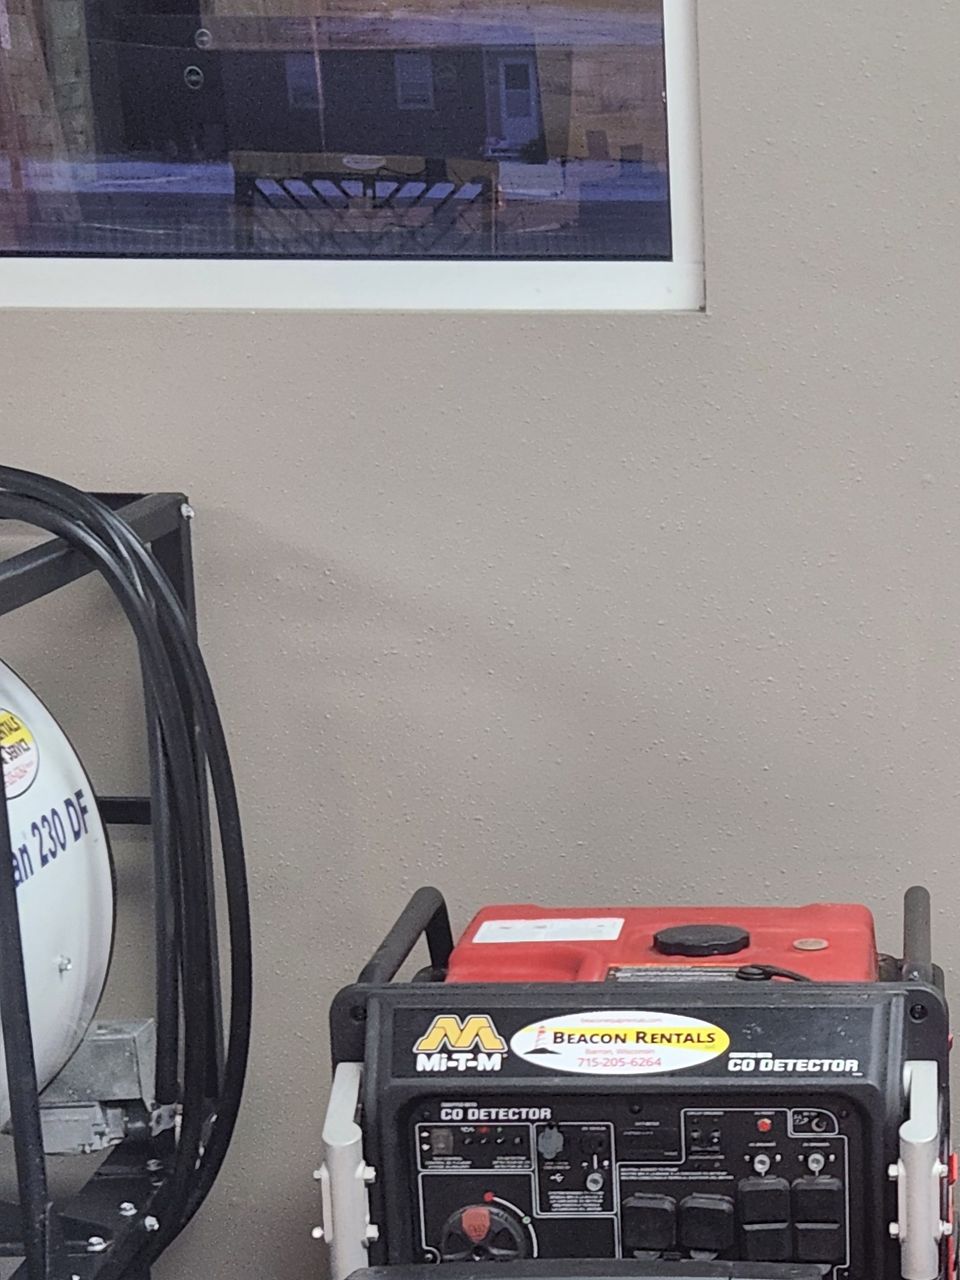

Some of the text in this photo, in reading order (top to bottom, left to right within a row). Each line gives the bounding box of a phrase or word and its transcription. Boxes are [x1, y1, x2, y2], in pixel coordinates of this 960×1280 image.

[31, 808, 67, 868] 230
[64, 790, 88, 842] DF
[553, 1030, 716, 1045] BEACON RENTALS
[416, 1053, 503, 1072] Mi-T-M
[577, 1057, 662, 1068] 715-205-6264
[728, 1059, 859, 1072] CO DETECTOR
[440, 1108, 552, 1120] CO DETECTOR
